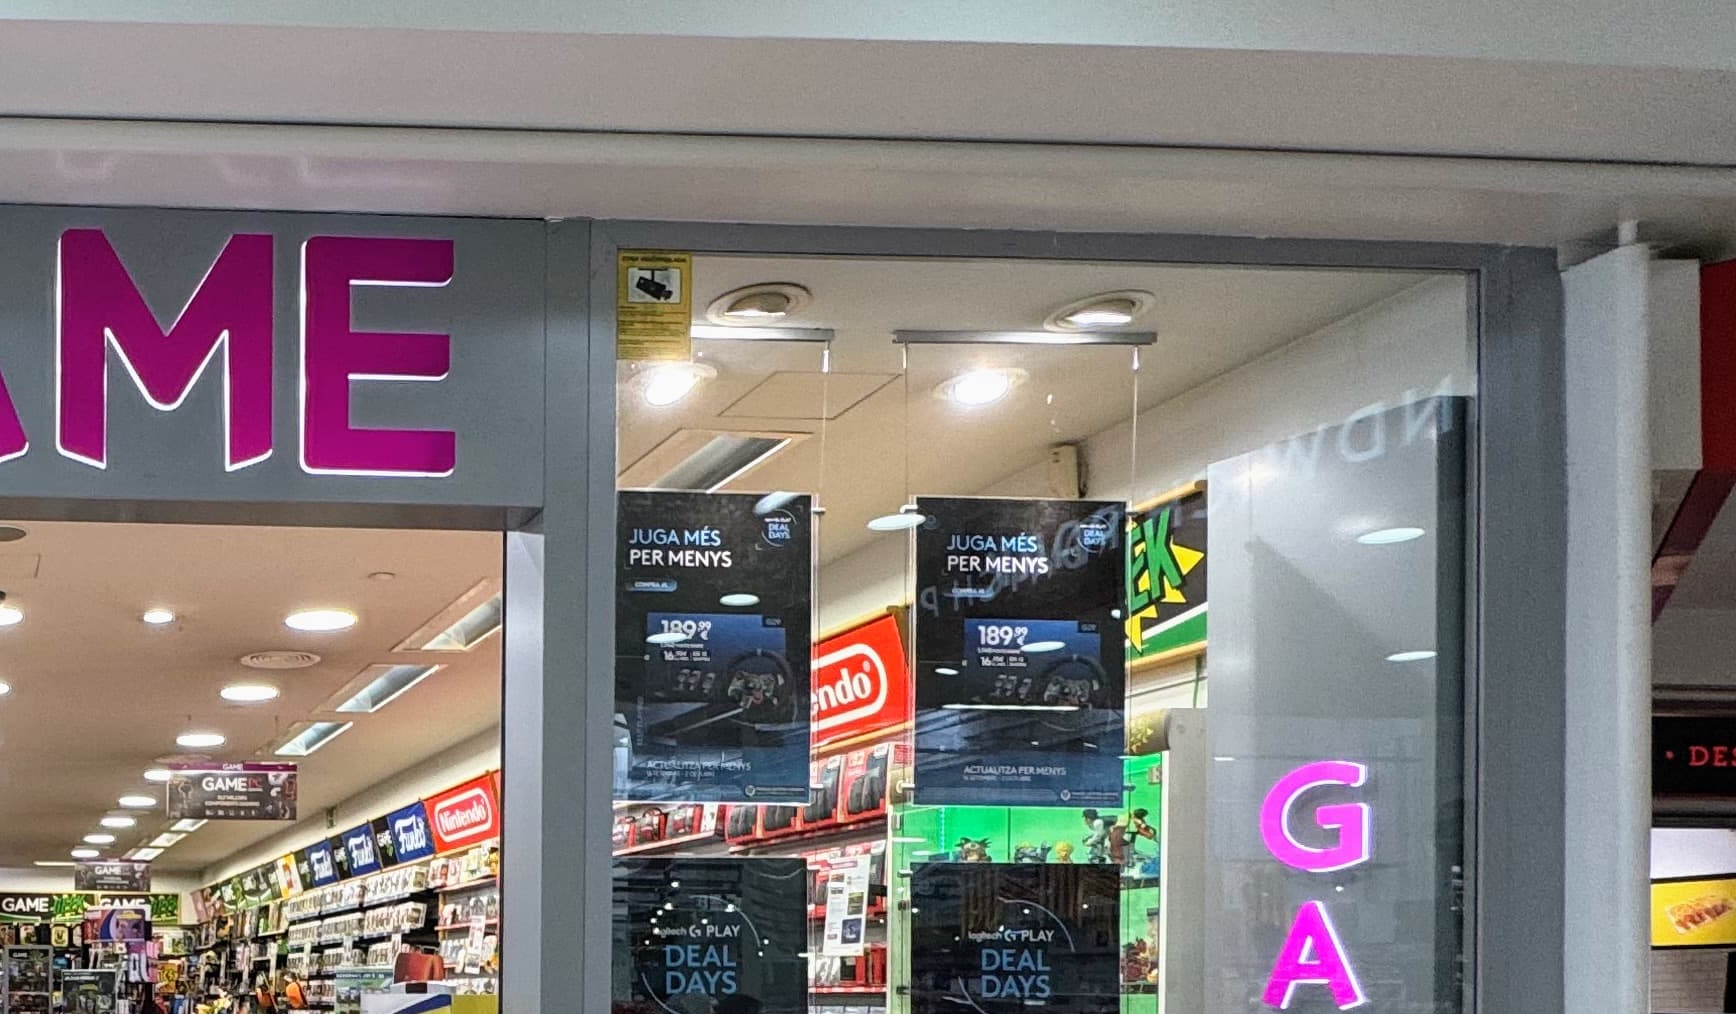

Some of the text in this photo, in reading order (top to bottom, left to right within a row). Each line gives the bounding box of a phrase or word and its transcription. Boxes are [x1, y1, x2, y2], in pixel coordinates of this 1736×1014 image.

[629, 525, 721, 547] JUGA MÉS
[768, 523, 789, 532] DEAL
[768, 531, 790, 540] DAYS
[947, 532, 1038, 552] JUGA MÉS
[630, 550, 732, 568] PER MENYS
[948, 555, 1049, 574] PER MENYS
[964, 765, 1066, 776] ACTUALITZA PER MENYS
[202, 777, 247, 791] GAME
[439, 799, 488, 833] Nintendo
[394, 815, 425, 855] Funko
[349, 834, 375, 867] Funko
[95, 866, 122, 875] GAME
[2, 898, 49, 912] GAME
[706, 925, 740, 937] PLAY
[968, 930, 1055, 942] logitech PLAY
[664, 944, 736, 967] DEAL
[982, 949, 1051, 971] DEAL
[666, 971, 737, 994] DAYS
[981, 975, 1051, 998] DAYS
